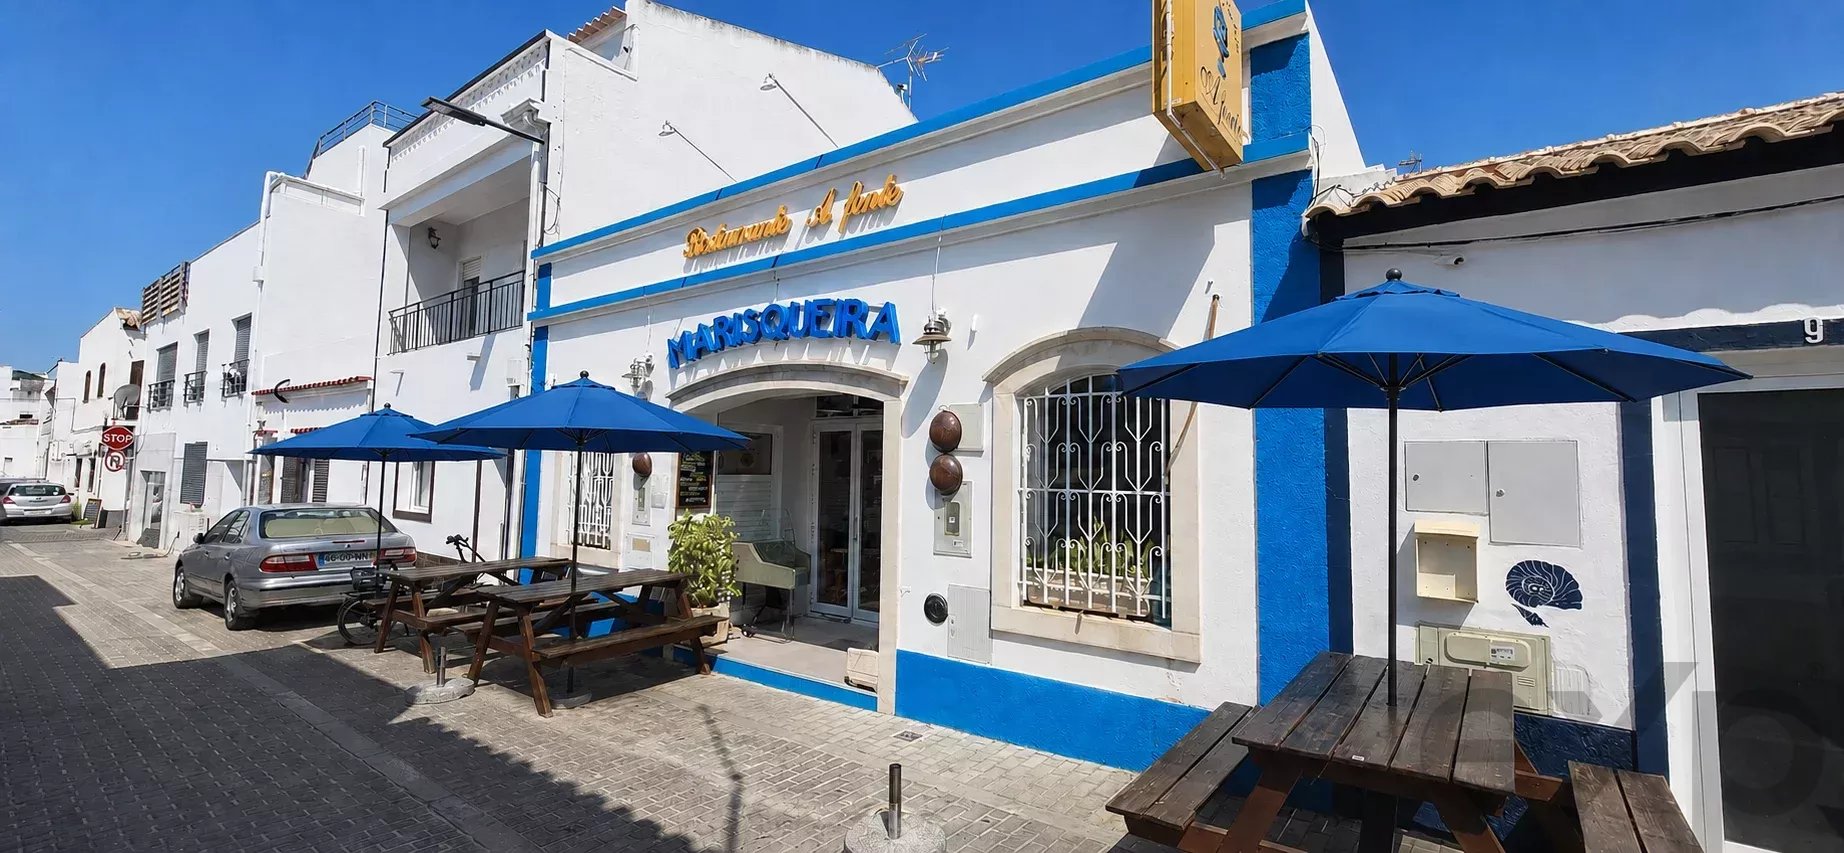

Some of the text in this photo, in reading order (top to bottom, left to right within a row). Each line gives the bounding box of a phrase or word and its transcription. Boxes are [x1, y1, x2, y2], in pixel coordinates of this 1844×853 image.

[683, 204, 793, 260] Restaurante
[667, 297, 902, 370] MARISQUEIRA
[1804, 314, 1823, 344] 9
[103, 433, 133, 443] STOP
